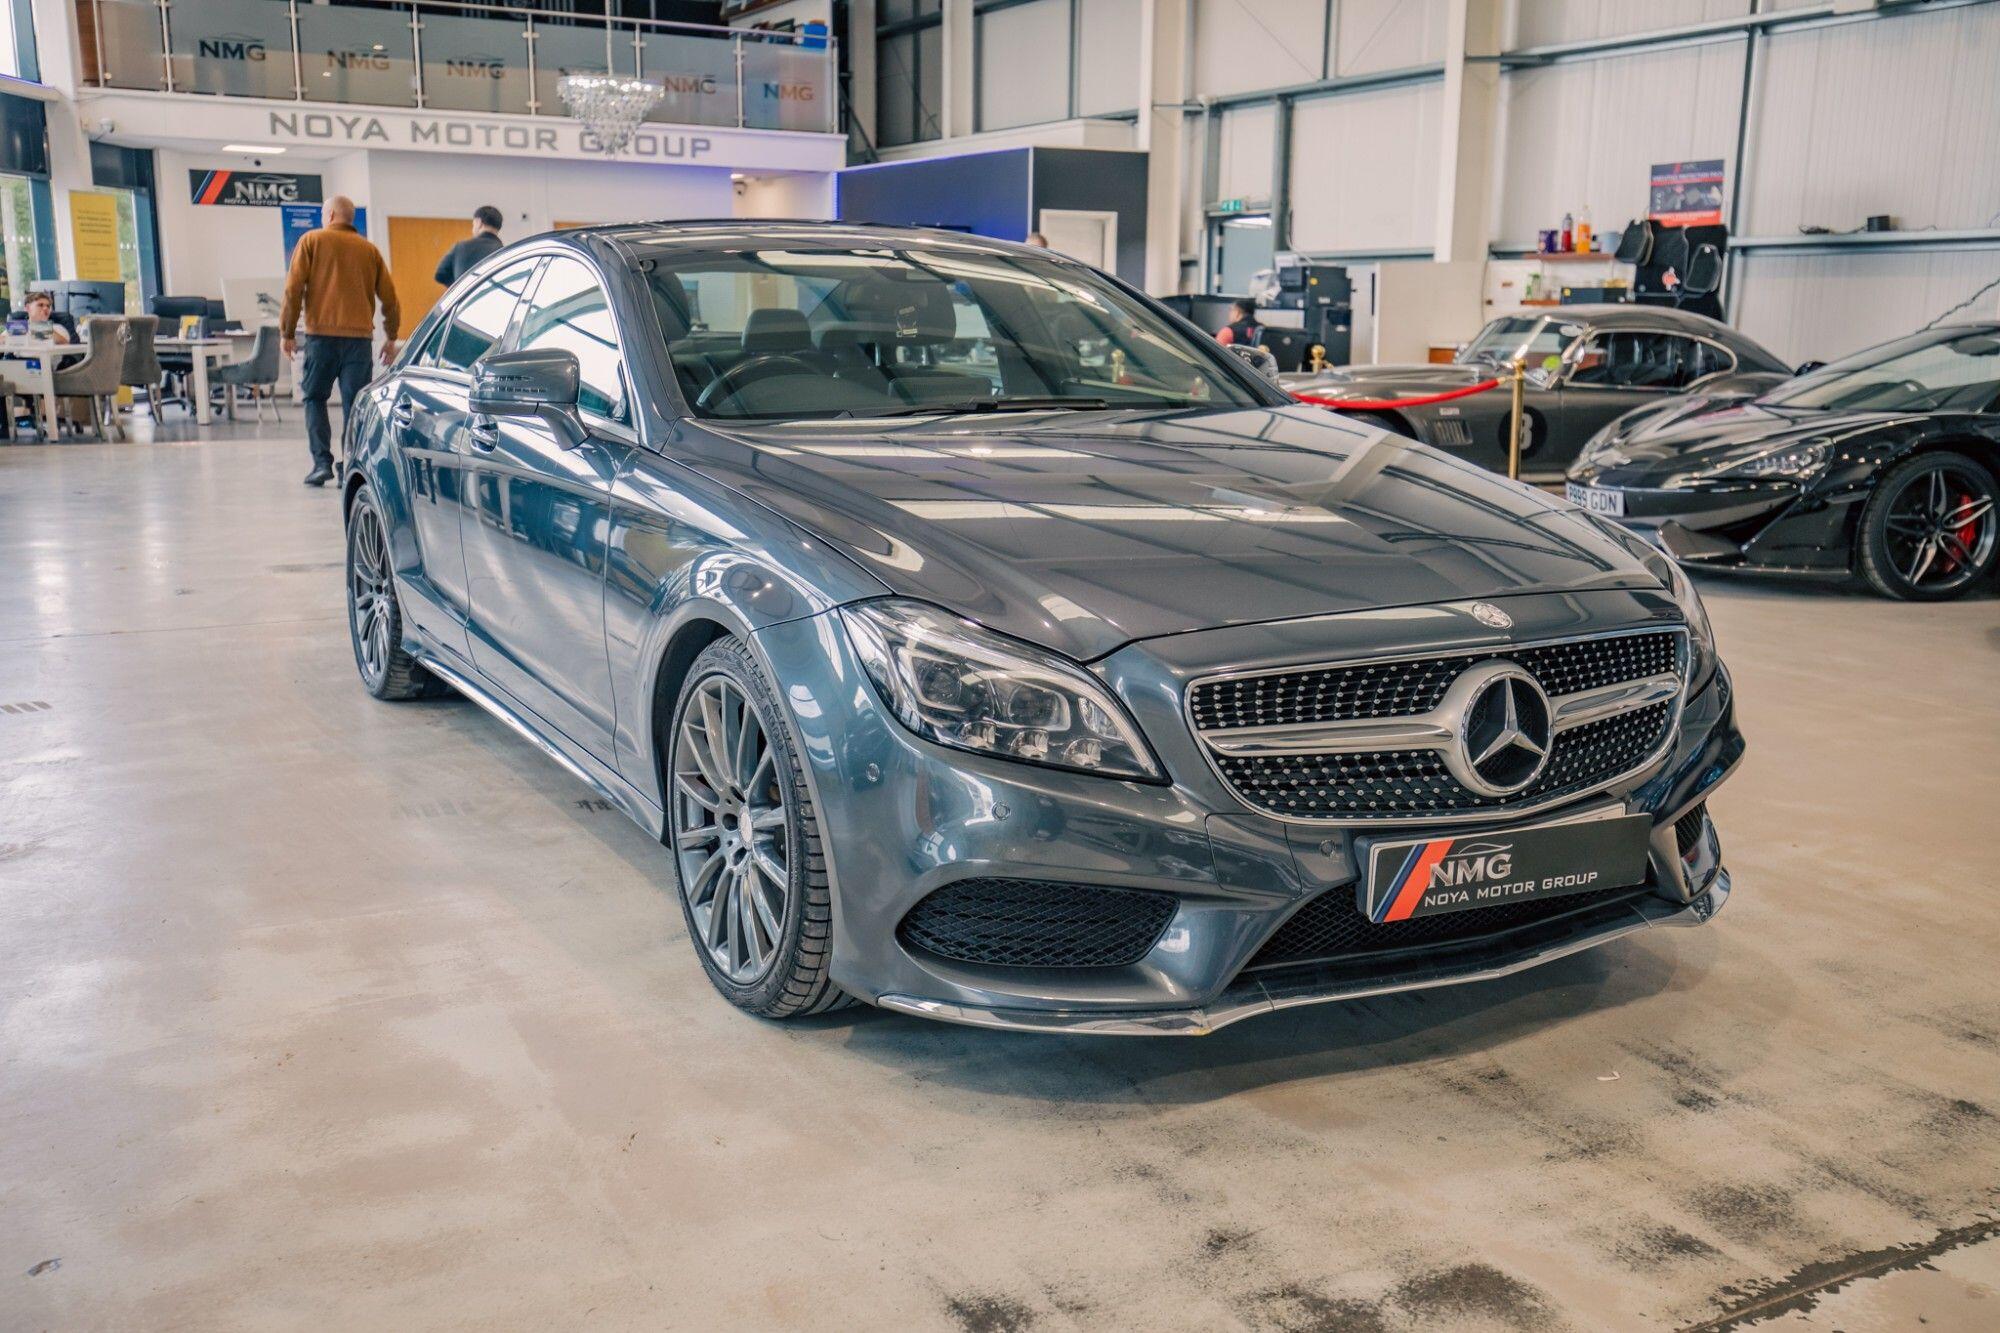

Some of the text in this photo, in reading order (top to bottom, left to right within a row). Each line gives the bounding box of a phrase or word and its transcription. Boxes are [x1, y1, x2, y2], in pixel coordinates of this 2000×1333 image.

[199, 39, 266, 61] NMG
[327, 50, 390, 70] NMG
[446, 60, 506, 79] NMG
[763, 82, 814, 101] NMG
[269, 111, 711, 158] NOYA MOTOR GOUP
[233, 181, 298, 200] NMG
[1590, 492, 1617, 513] GDN
[1428, 853, 1512, 889] NMG
[1424, 871, 1599, 907] NOYA MOTOR GROUP
